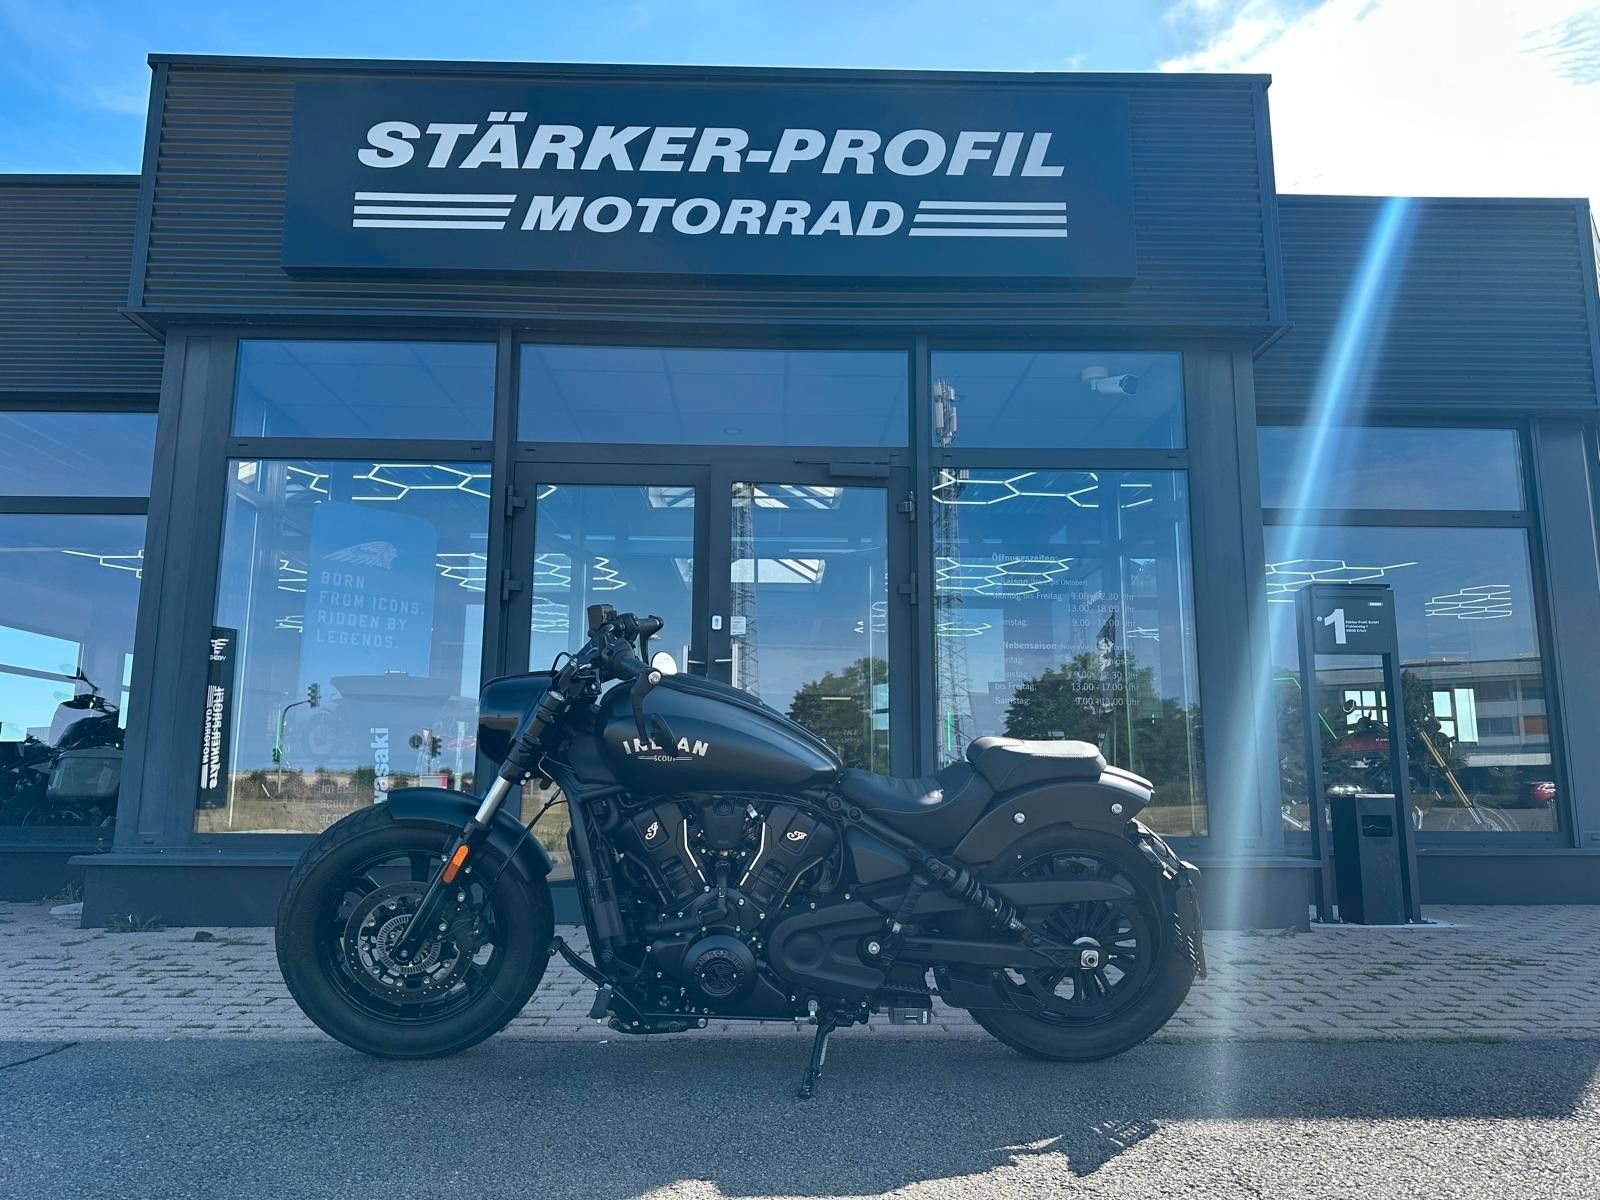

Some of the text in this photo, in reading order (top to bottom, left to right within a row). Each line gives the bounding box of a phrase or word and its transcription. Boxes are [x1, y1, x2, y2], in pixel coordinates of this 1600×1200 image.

[357, 111, 1065, 177] STÄRKER-PROFIL
[520, 195, 904, 236] MOTORRAD
[320, 571, 366, 589] BORN
[319, 590, 425, 616] FROM ICONS.
[317, 609, 409, 632] RIDDEN BY
[1324, 608, 1346, 644] 1
[316, 629, 399, 649] LEGENDS.
[1003, 641, 1057, 650] Nebensaison
